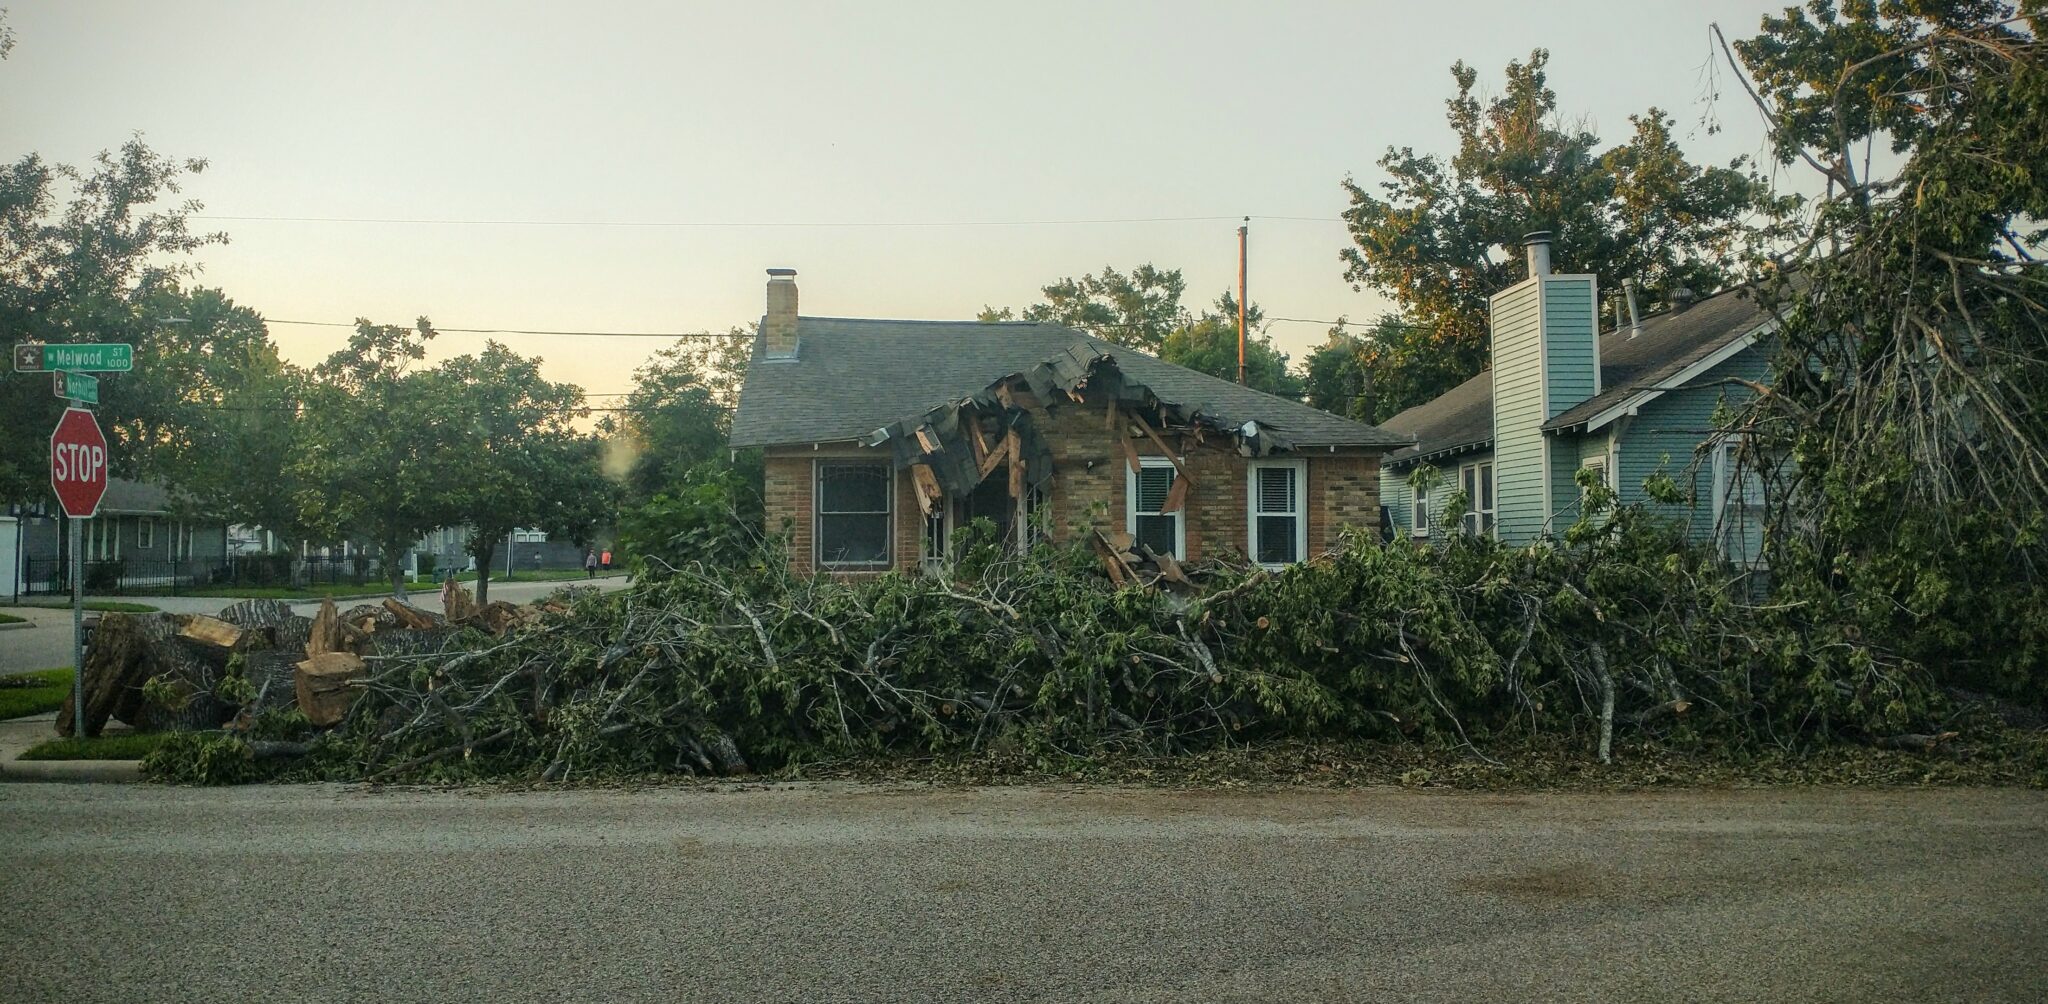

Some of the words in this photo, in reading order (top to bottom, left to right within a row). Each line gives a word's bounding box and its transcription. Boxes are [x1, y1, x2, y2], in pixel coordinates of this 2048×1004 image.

[56, 349, 102, 366] Melwood
[112, 347, 123, 357] ST
[107, 359, 128, 368] 1000
[56, 442, 103, 483] STOP
